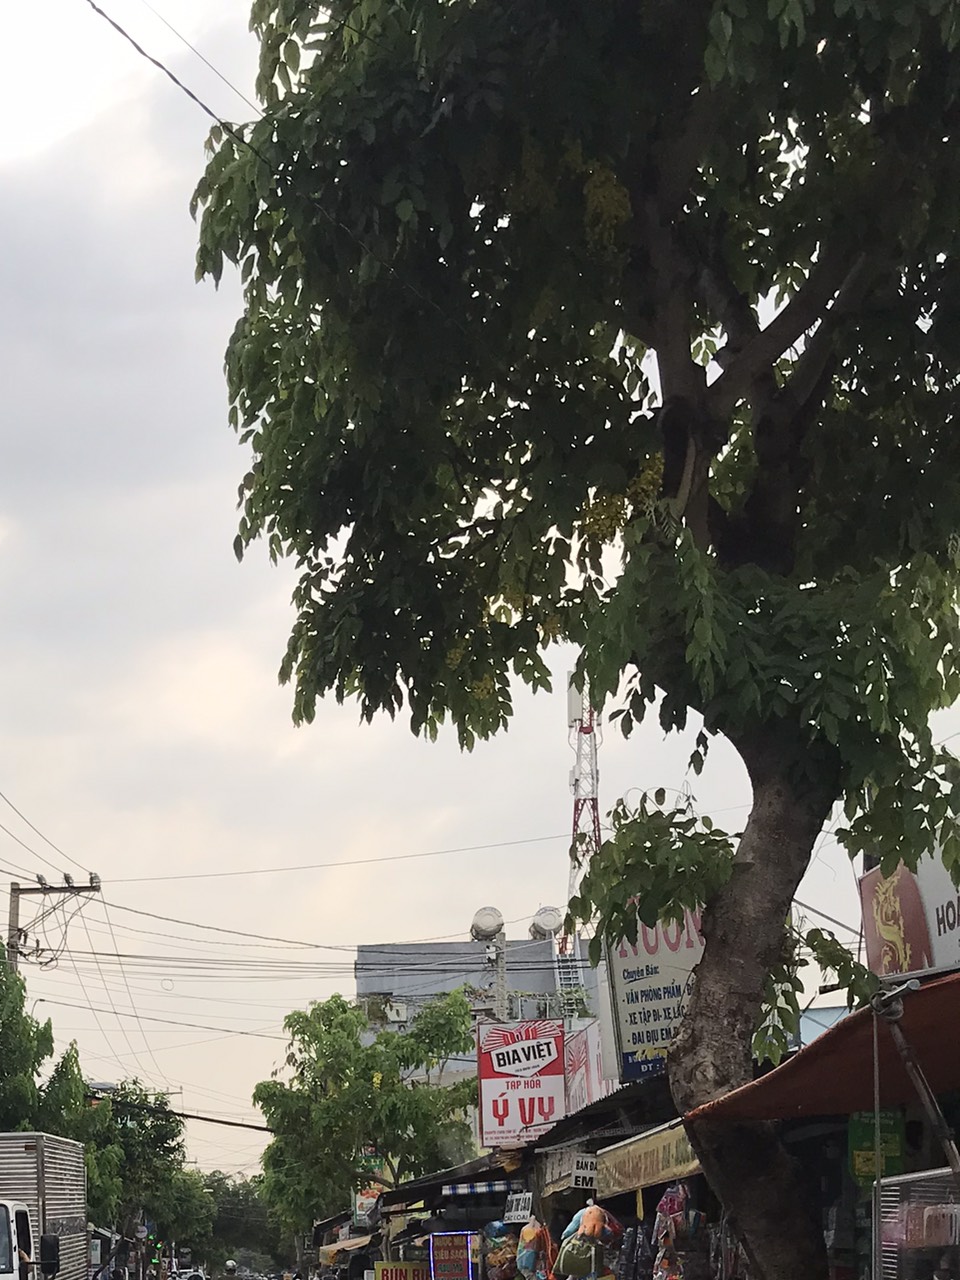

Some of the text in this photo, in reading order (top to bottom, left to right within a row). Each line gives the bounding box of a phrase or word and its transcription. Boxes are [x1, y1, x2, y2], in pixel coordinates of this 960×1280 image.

[495, 1041, 552, 1068] BIA VIỆT
[492, 1092, 554, 1126] Ý VY
[574, 1176, 593, 1187] EM
